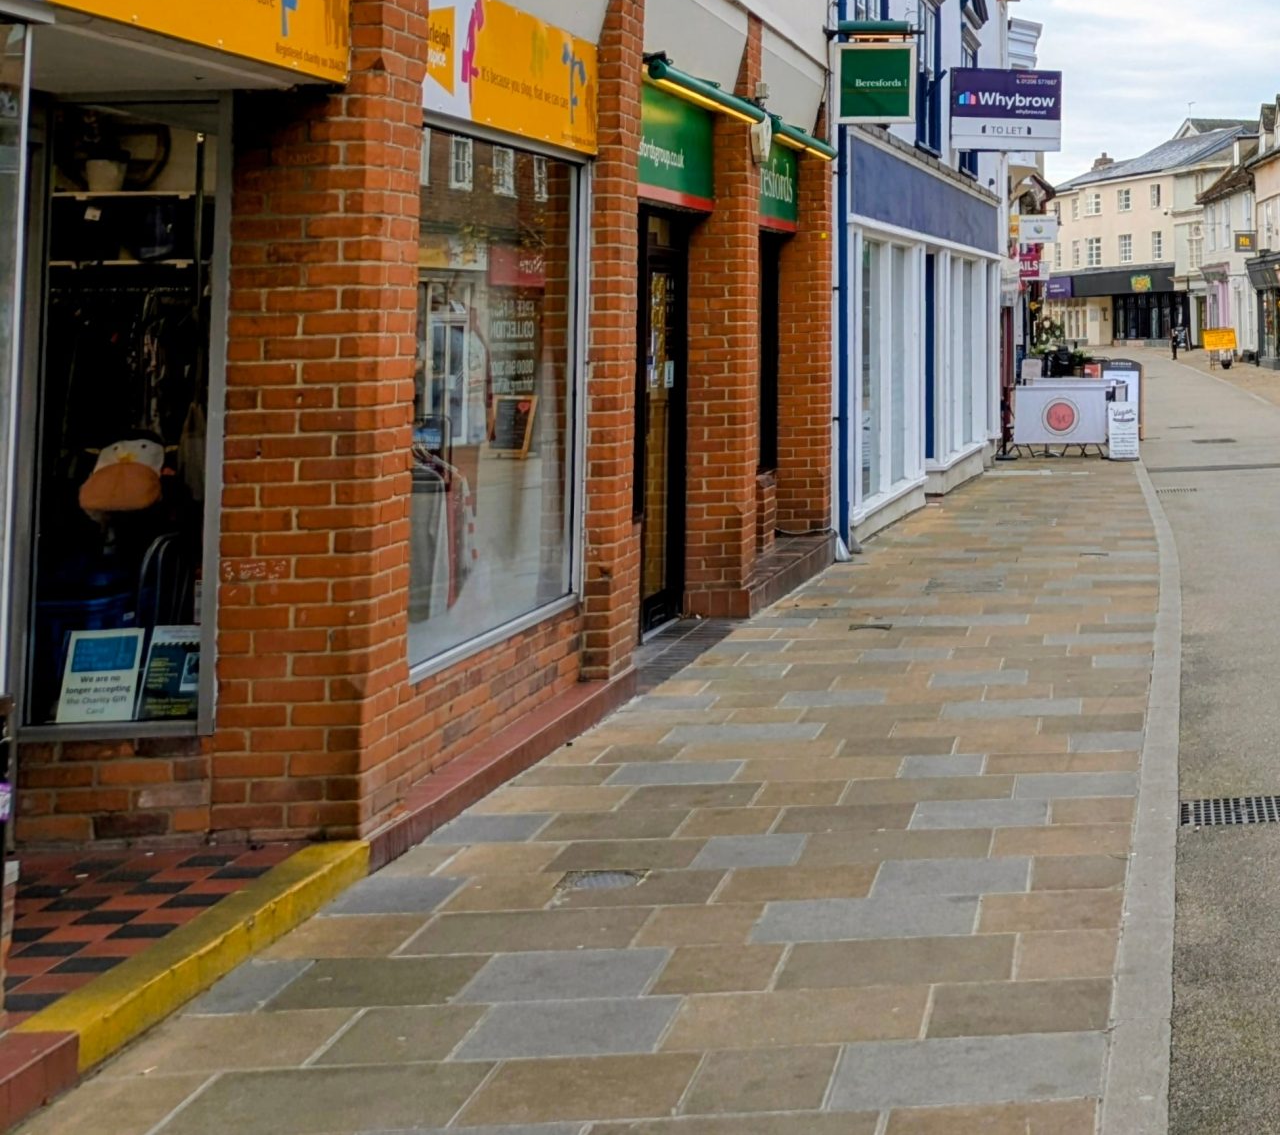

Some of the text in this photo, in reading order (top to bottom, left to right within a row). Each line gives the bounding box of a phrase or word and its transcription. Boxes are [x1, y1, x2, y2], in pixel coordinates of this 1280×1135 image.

[855, 78, 902, 87] Beresfords
[978, 92, 1055, 110] Whybrow
[991, 125, 1024, 135] TO LET
[66, 685, 131, 695] longer accepting
